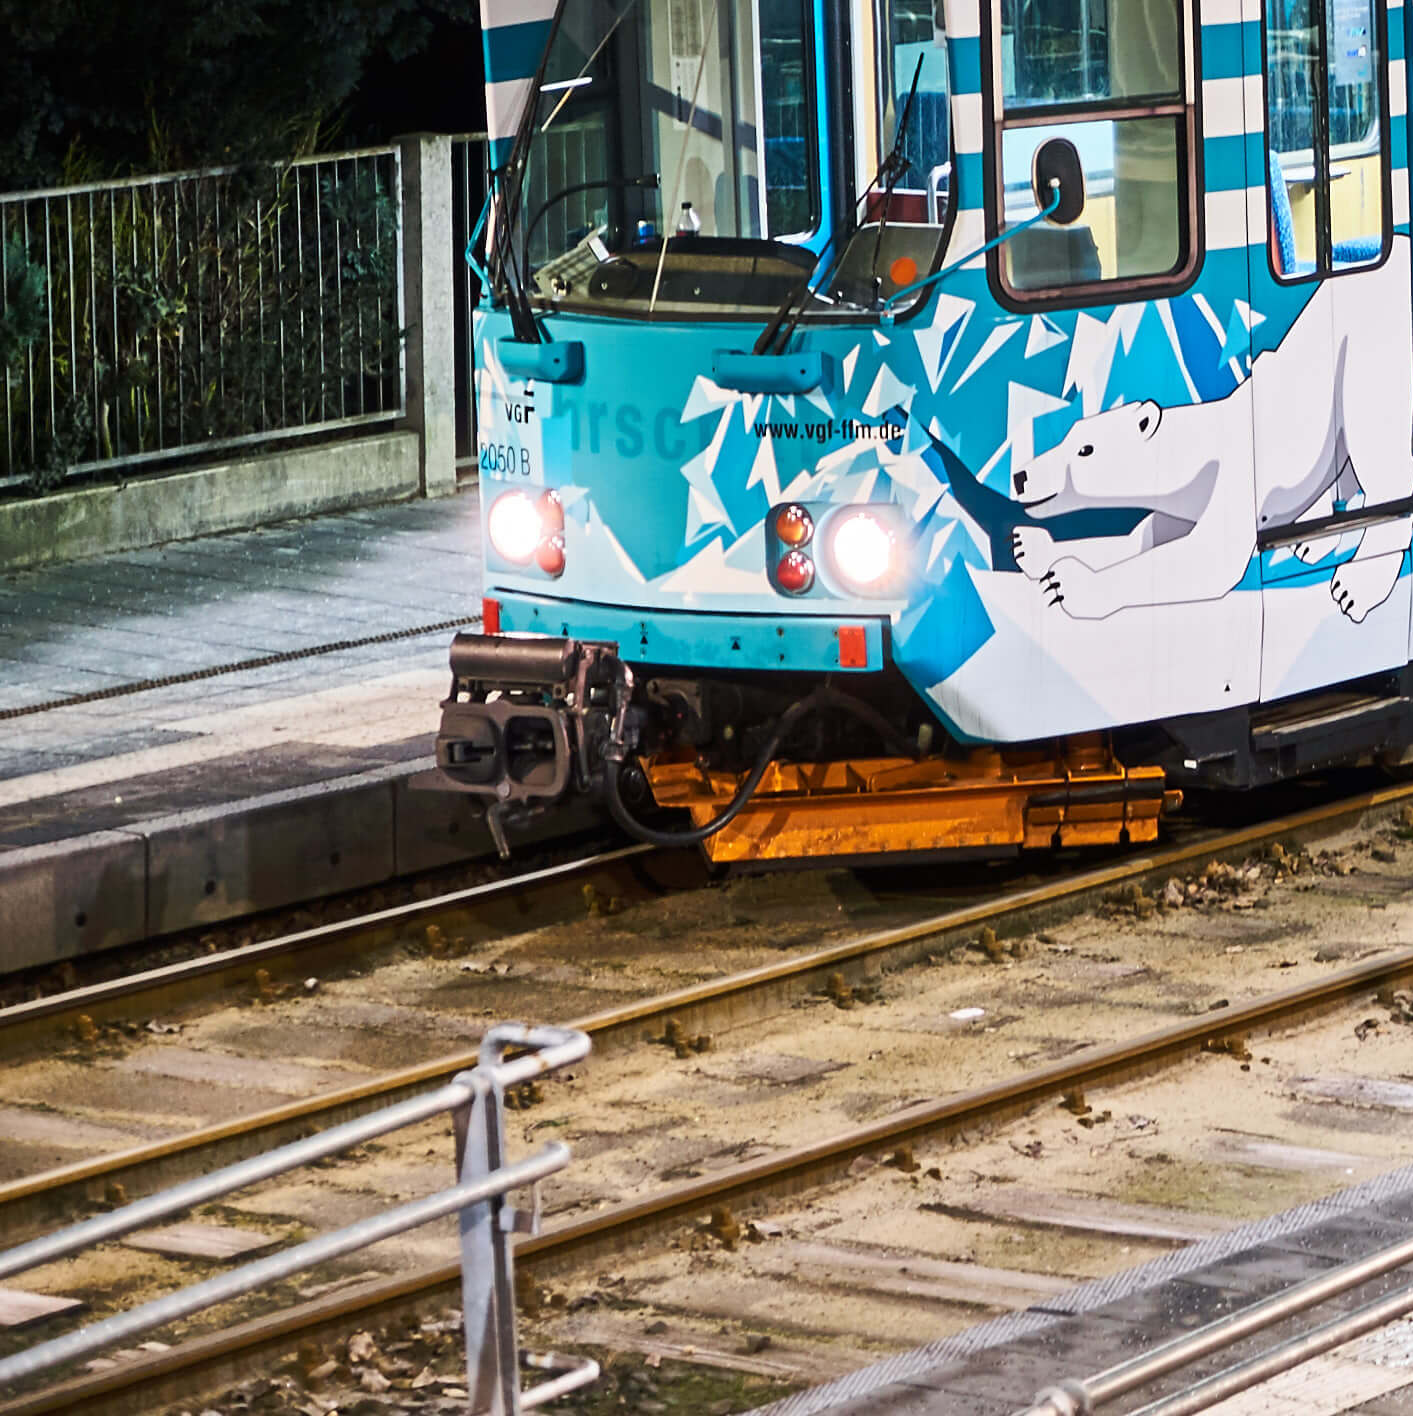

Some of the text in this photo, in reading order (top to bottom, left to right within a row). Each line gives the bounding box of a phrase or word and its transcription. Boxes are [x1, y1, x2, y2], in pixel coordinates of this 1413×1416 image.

[754, 420, 902, 444] www.vgf-ffm.de
[480, 442, 531, 476] 2050 B
